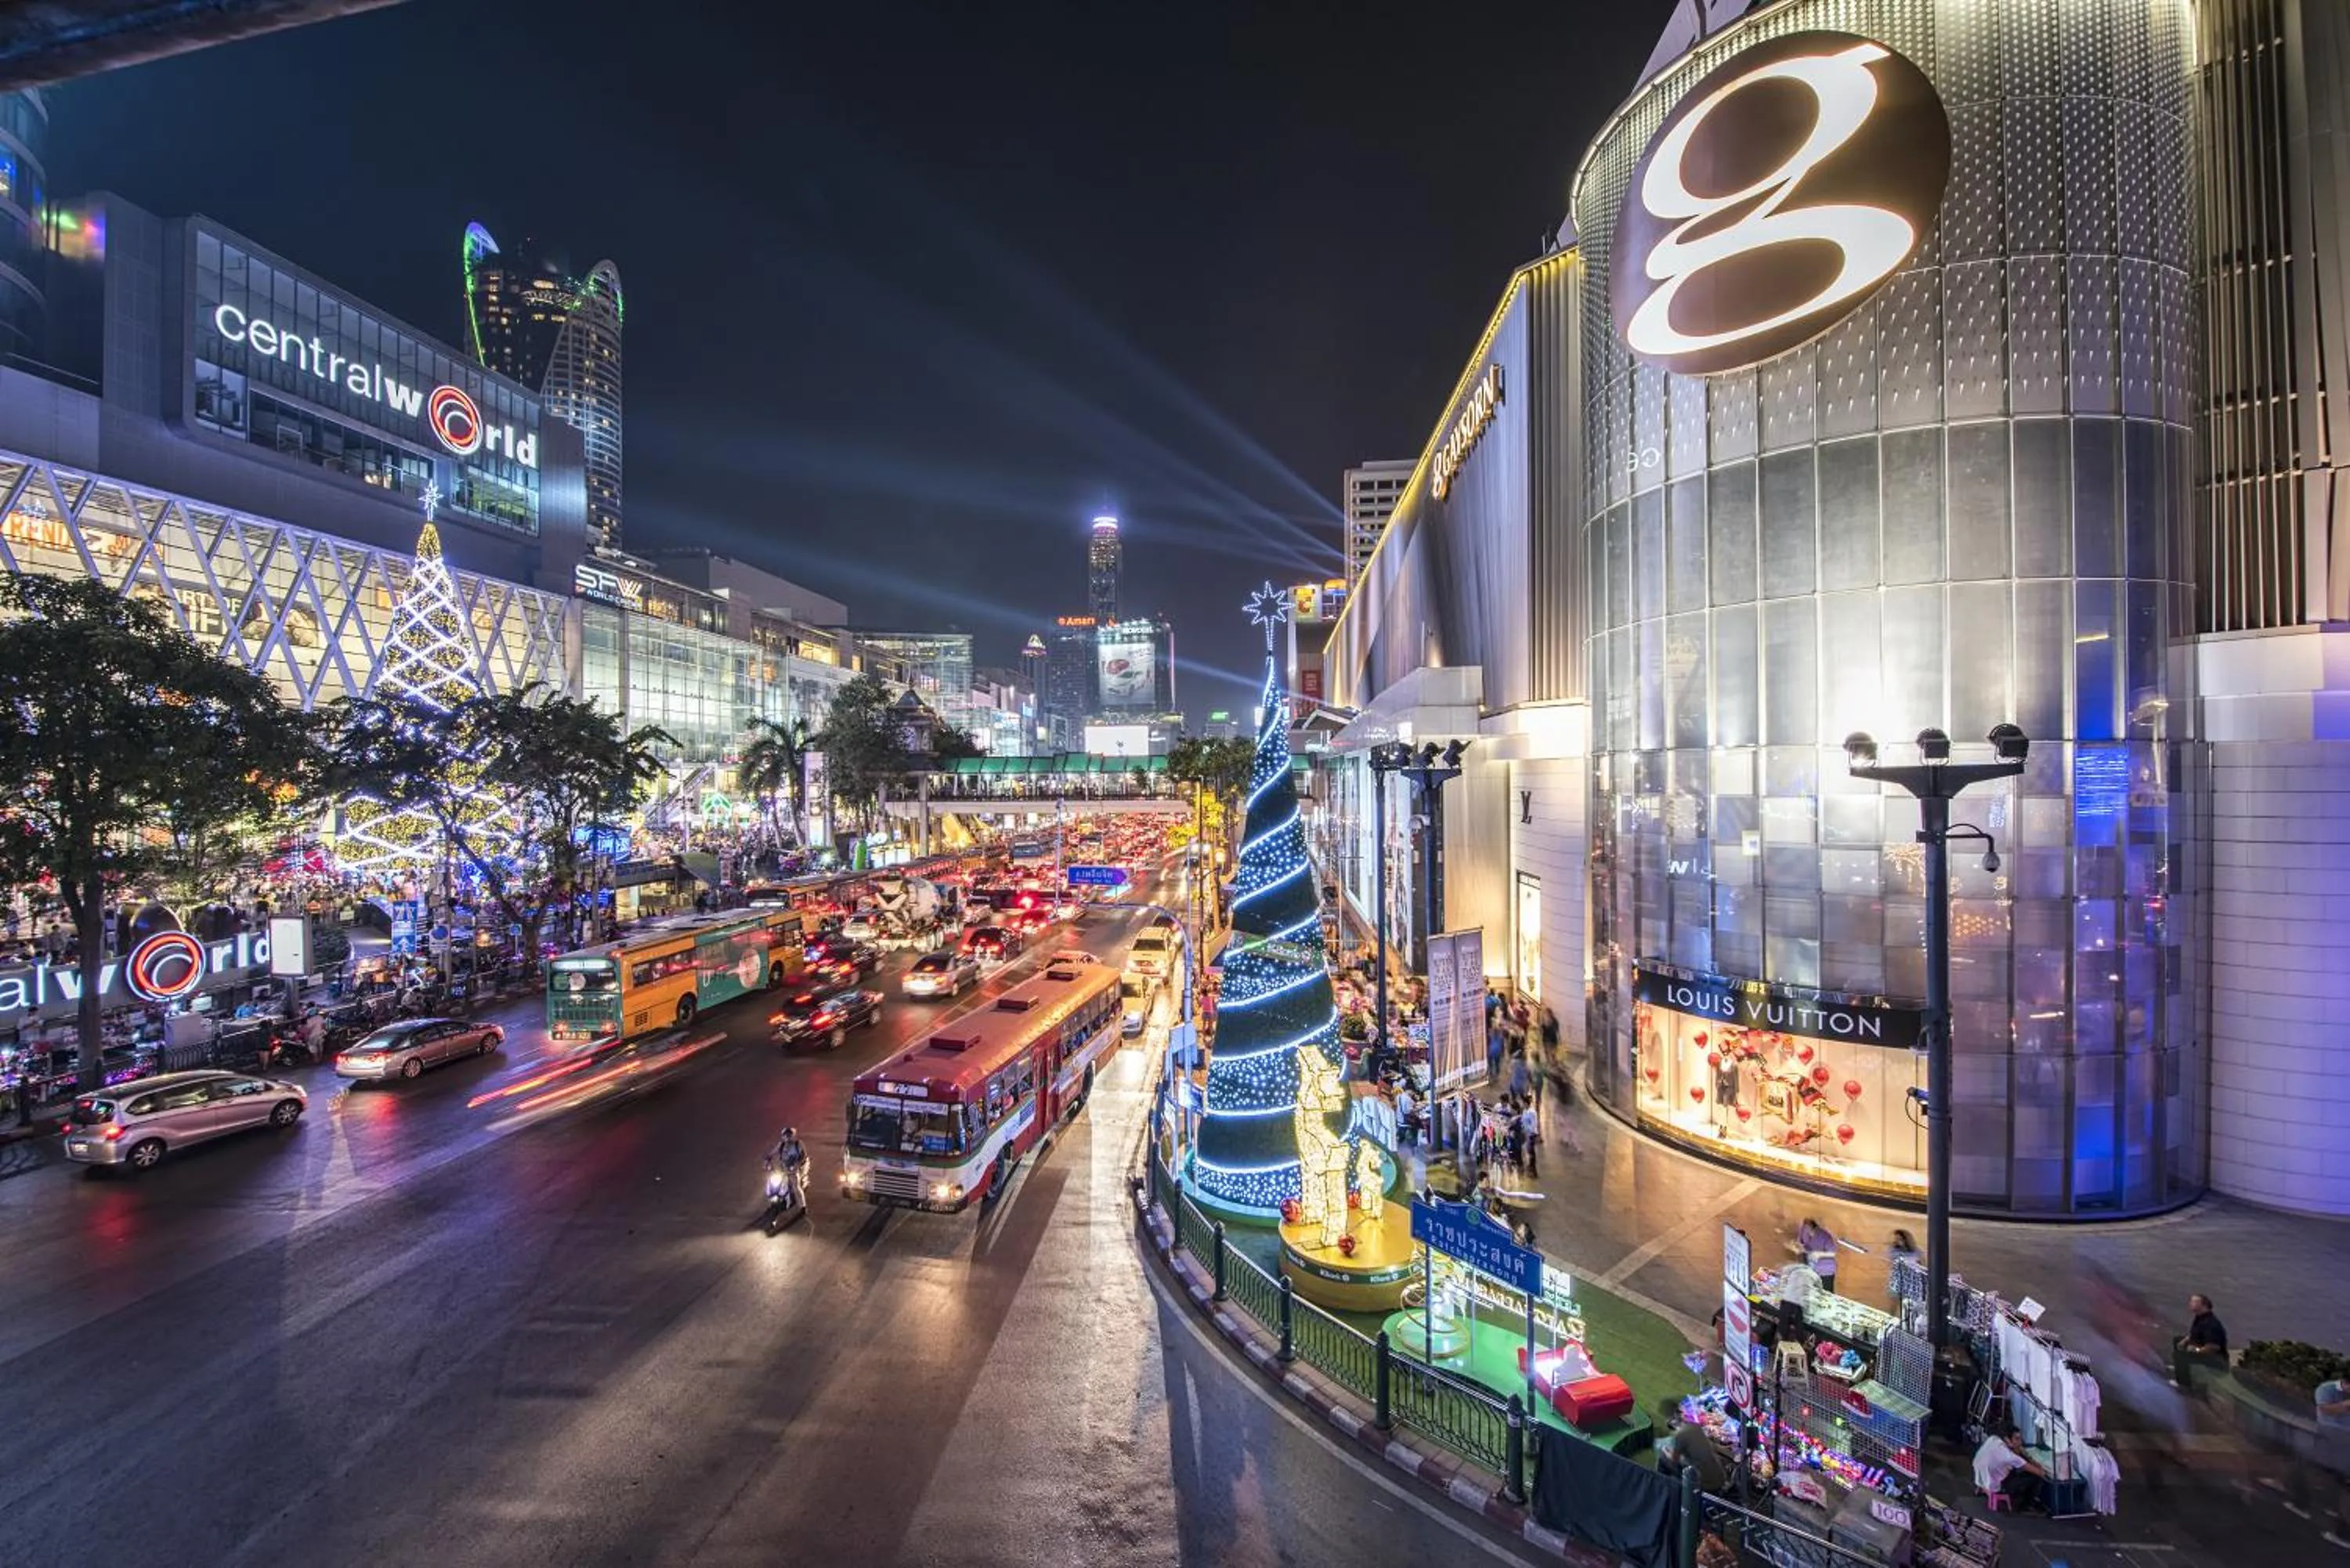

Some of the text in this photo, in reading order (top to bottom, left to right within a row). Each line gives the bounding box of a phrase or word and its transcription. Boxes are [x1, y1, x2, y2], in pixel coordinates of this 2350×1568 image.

[1626, 43, 1916, 355] g
[1442, 363, 1495, 476] GAYSORN
[1668, 984, 1882, 1038] LOUIS VUITTON
[1425, 1217, 1528, 1275] ราชประสงค์
[1877, 1502, 1908, 1526] 100
